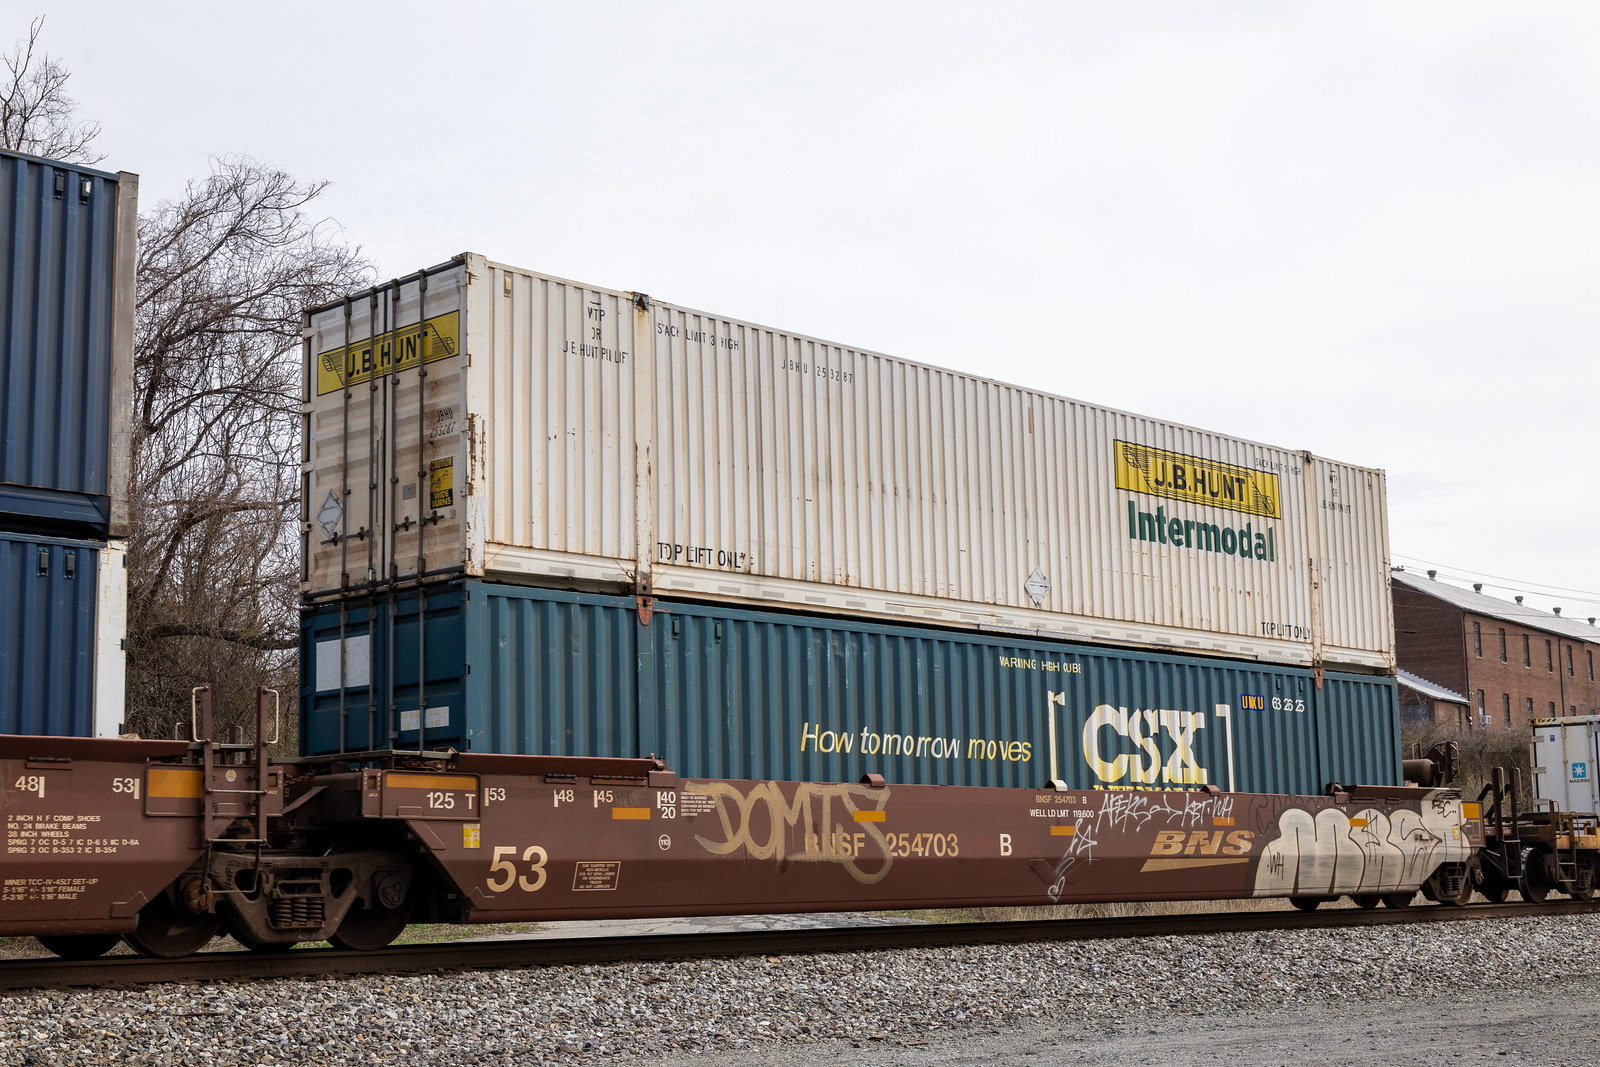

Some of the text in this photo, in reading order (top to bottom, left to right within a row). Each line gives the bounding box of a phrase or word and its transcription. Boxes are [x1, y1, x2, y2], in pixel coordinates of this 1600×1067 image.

[710, 335, 715, 346] 3
[437, 408, 454, 422] JBHU
[434, 490, 449, 500] WIDE
[432, 497, 452, 508] TURNS
[1128, 500, 1274, 562] Intermodal
[686, 546, 713, 564] LIFT
[800, 722, 1032, 762] How tomorrow moves
[1083, 704, 1207, 784] CSX
[15, 776, 38, 791] 48
[112, 778, 134, 792] 53
[426, 792, 476, 810] 125 T
[489, 788, 506, 801] 53
[558, 790, 574, 802] 48
[598, 790, 614, 802] 45
[661, 792, 676, 804] 40
[1036, 794, 1087, 804] BNSF 254703 B
[662, 806, 676, 819] 20
[1030, 808, 1047, 817] WELL
[1048, 809, 1056, 818] LD
[1057, 810, 1069, 818] LMT
[804, 832, 1012, 857] BNSF 254703 B
[1150, 830, 1254, 856] BNS
[486, 846, 548, 892] 53
